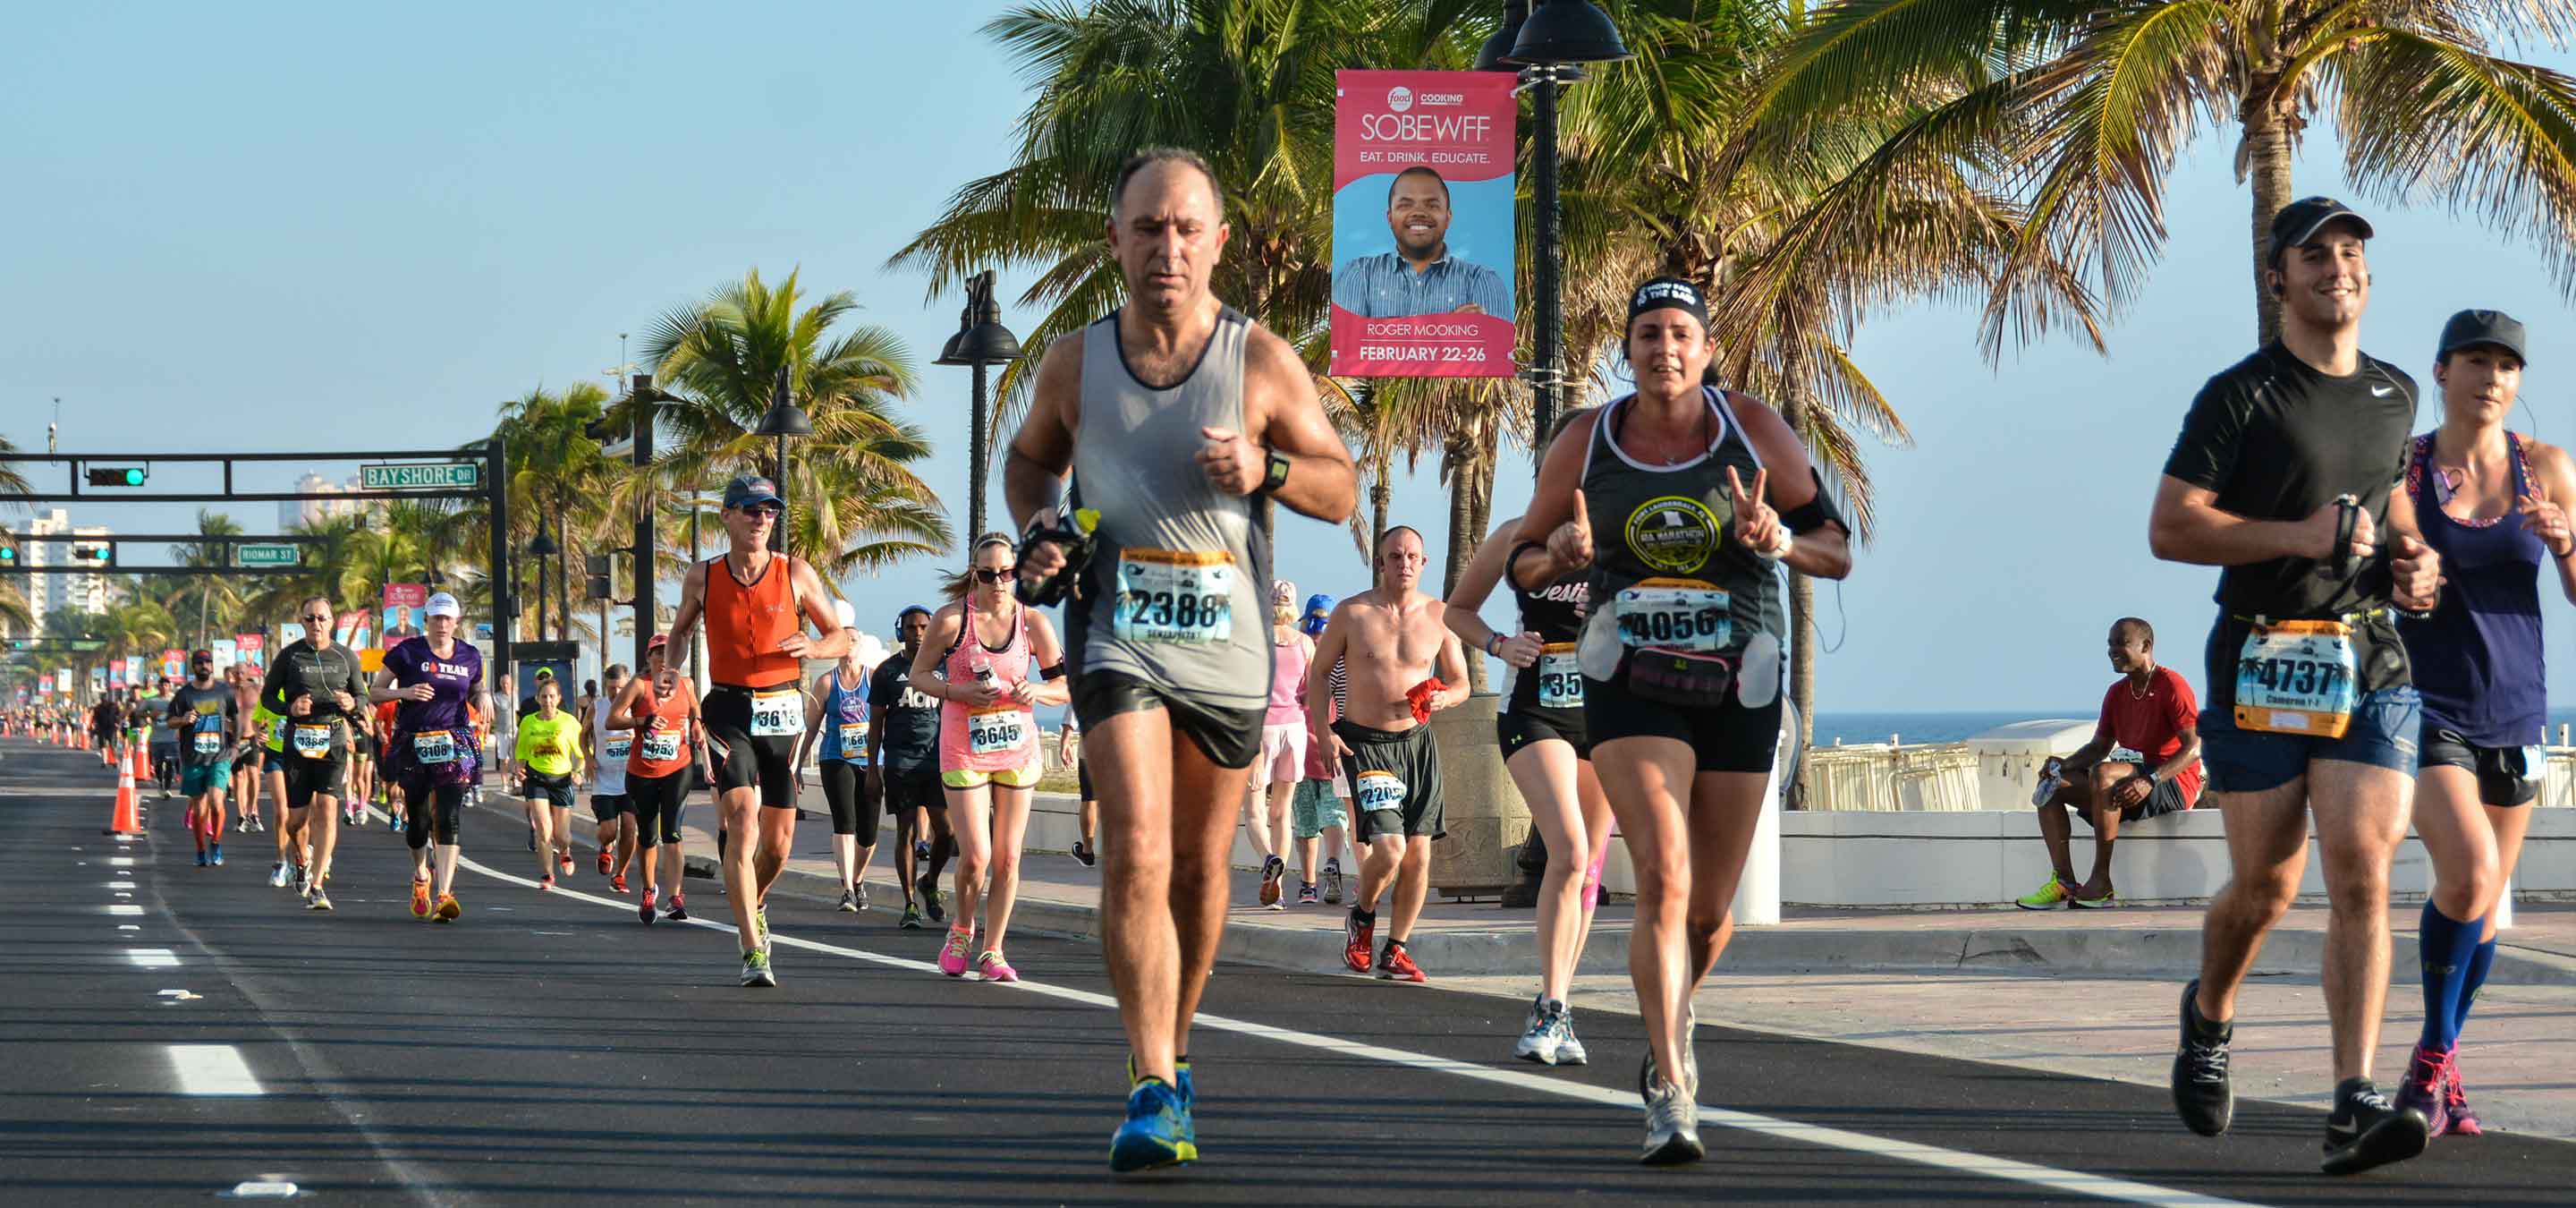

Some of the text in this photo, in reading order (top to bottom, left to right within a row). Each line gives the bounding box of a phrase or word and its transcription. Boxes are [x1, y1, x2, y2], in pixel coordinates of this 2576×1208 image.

[1388, 91, 1463, 105] food COOKING
[1360, 114, 1491, 142] SOBEWFF
[1360, 151, 1490, 164] EAT. DRINK. EDUCATE.
[1367, 323, 1479, 336] ROGER MOOKING
[1360, 346, 1487, 362] FEBRUARY 22-26
[368, 467, 472, 484] BAYSHORE DR
[1657, 529, 1705, 540] MARATHON
[242, 549, 292, 559] RIOMAR ST
[1131, 590, 1217, 627] 2388
[1631, 609, 1716, 641] 4056
[438, 662, 469, 677] TEAM
[2258, 658, 2334, 695] 4737
[977, 725, 1018, 745] 3645
[649, 744, 674, 756] 4753
